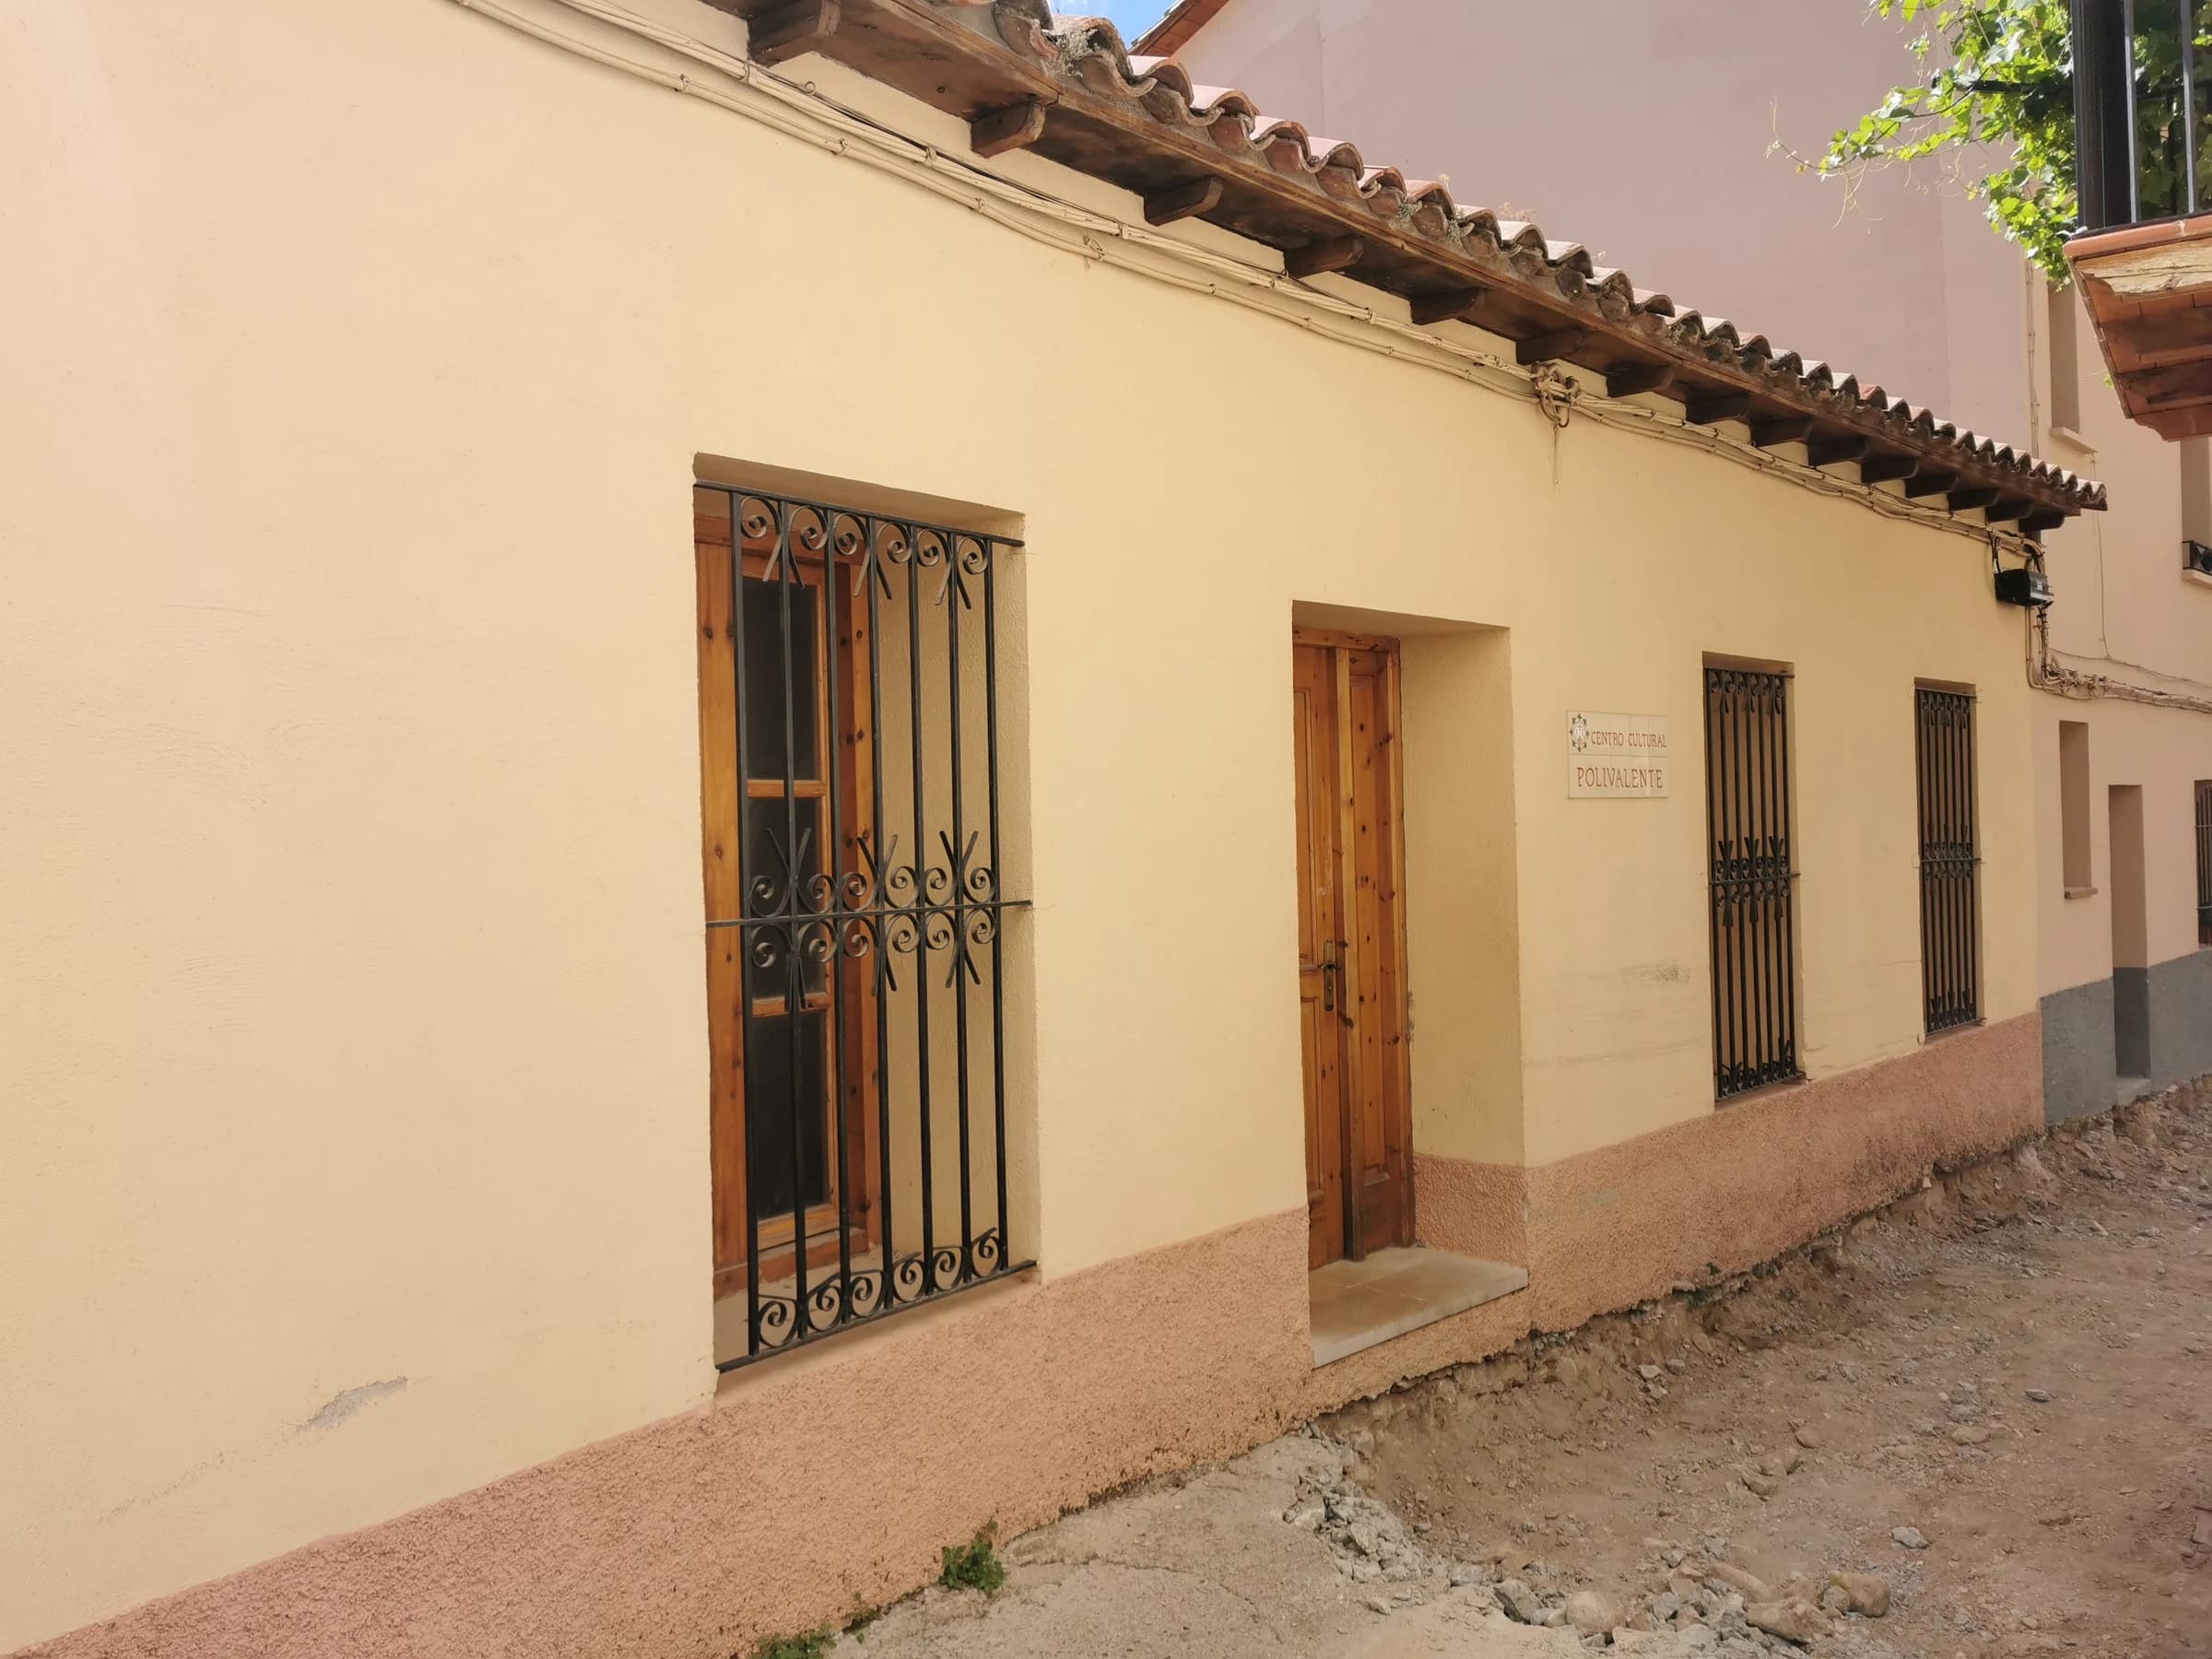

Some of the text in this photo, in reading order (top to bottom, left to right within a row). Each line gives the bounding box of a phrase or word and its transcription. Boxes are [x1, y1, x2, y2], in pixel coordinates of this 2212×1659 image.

[1591, 731, 1667, 748] CENTRO CULTURAL
[1576, 767, 1664, 789] POLIVALENTE
